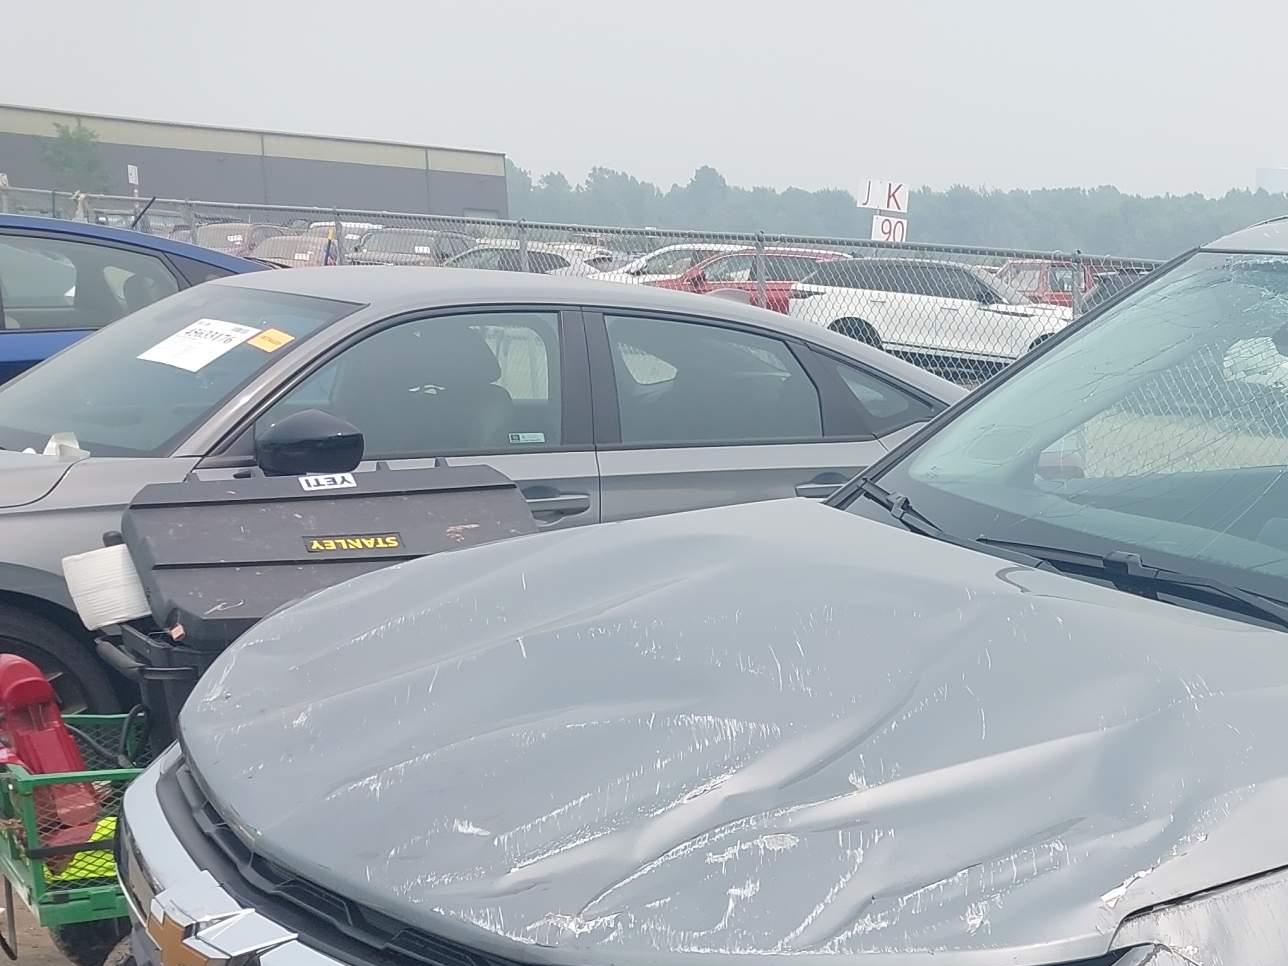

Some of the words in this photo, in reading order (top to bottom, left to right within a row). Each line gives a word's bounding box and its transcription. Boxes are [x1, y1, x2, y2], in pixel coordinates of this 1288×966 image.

[862, 180, 872, 206] J
[886, 182, 903, 210] K
[881, 218, 905, 242] 90
[304, 475, 352, 488] YETI
[311, 536, 399, 550] STANLEY
